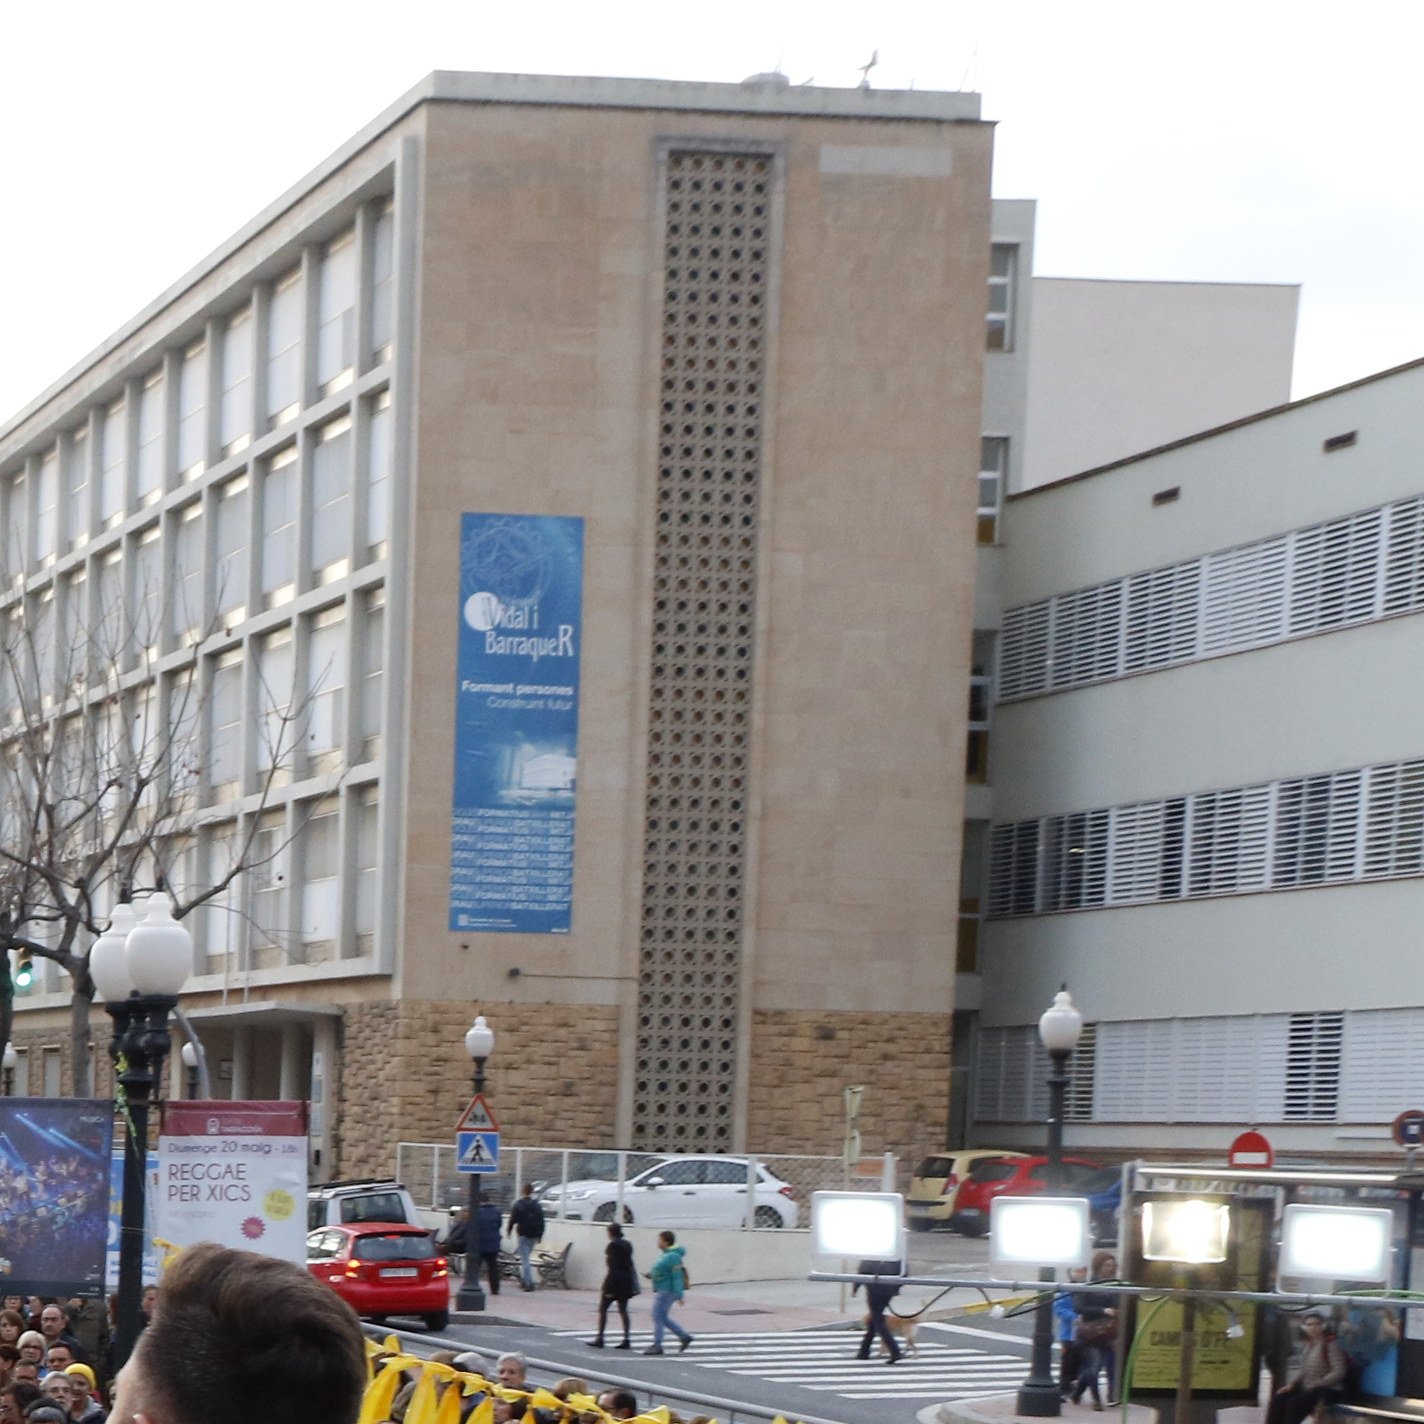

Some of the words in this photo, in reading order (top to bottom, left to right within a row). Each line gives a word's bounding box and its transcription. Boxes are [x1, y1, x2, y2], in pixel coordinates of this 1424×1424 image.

[461, 680, 514, 694] Formant
[516, 683, 573, 696] persones
[168, 1142, 218, 1154] Diumenge
[221, 1141, 238, 1153] 20
[240, 1142, 272, 1155] maig
[168, 1163, 248, 1181] REGGAE
[168, 1184, 201, 1202] PER
[206, 1183, 252, 1202] XICS
